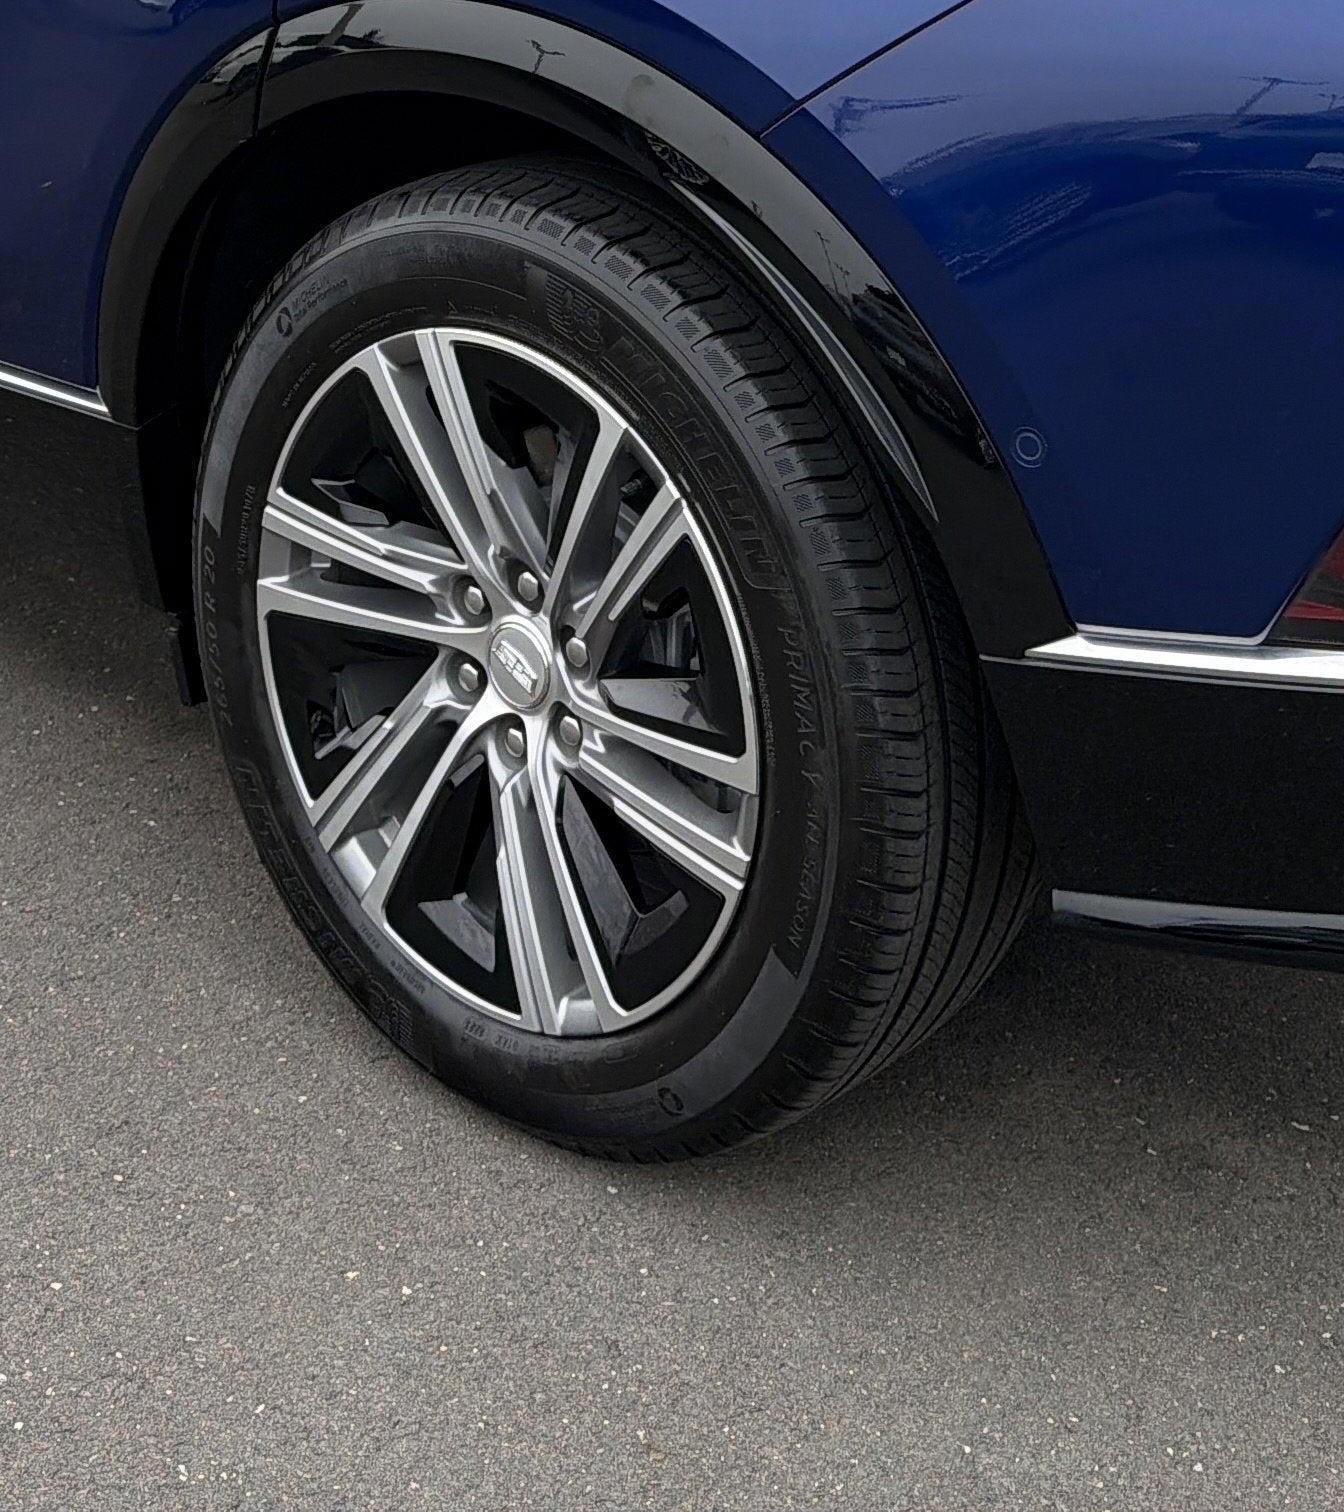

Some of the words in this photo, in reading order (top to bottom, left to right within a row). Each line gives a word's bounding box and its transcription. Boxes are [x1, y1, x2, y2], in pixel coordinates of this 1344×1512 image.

[602, 335, 780, 574] MICHELIN
[202, 544, 216, 585] 20
[203, 592, 217, 615] R
